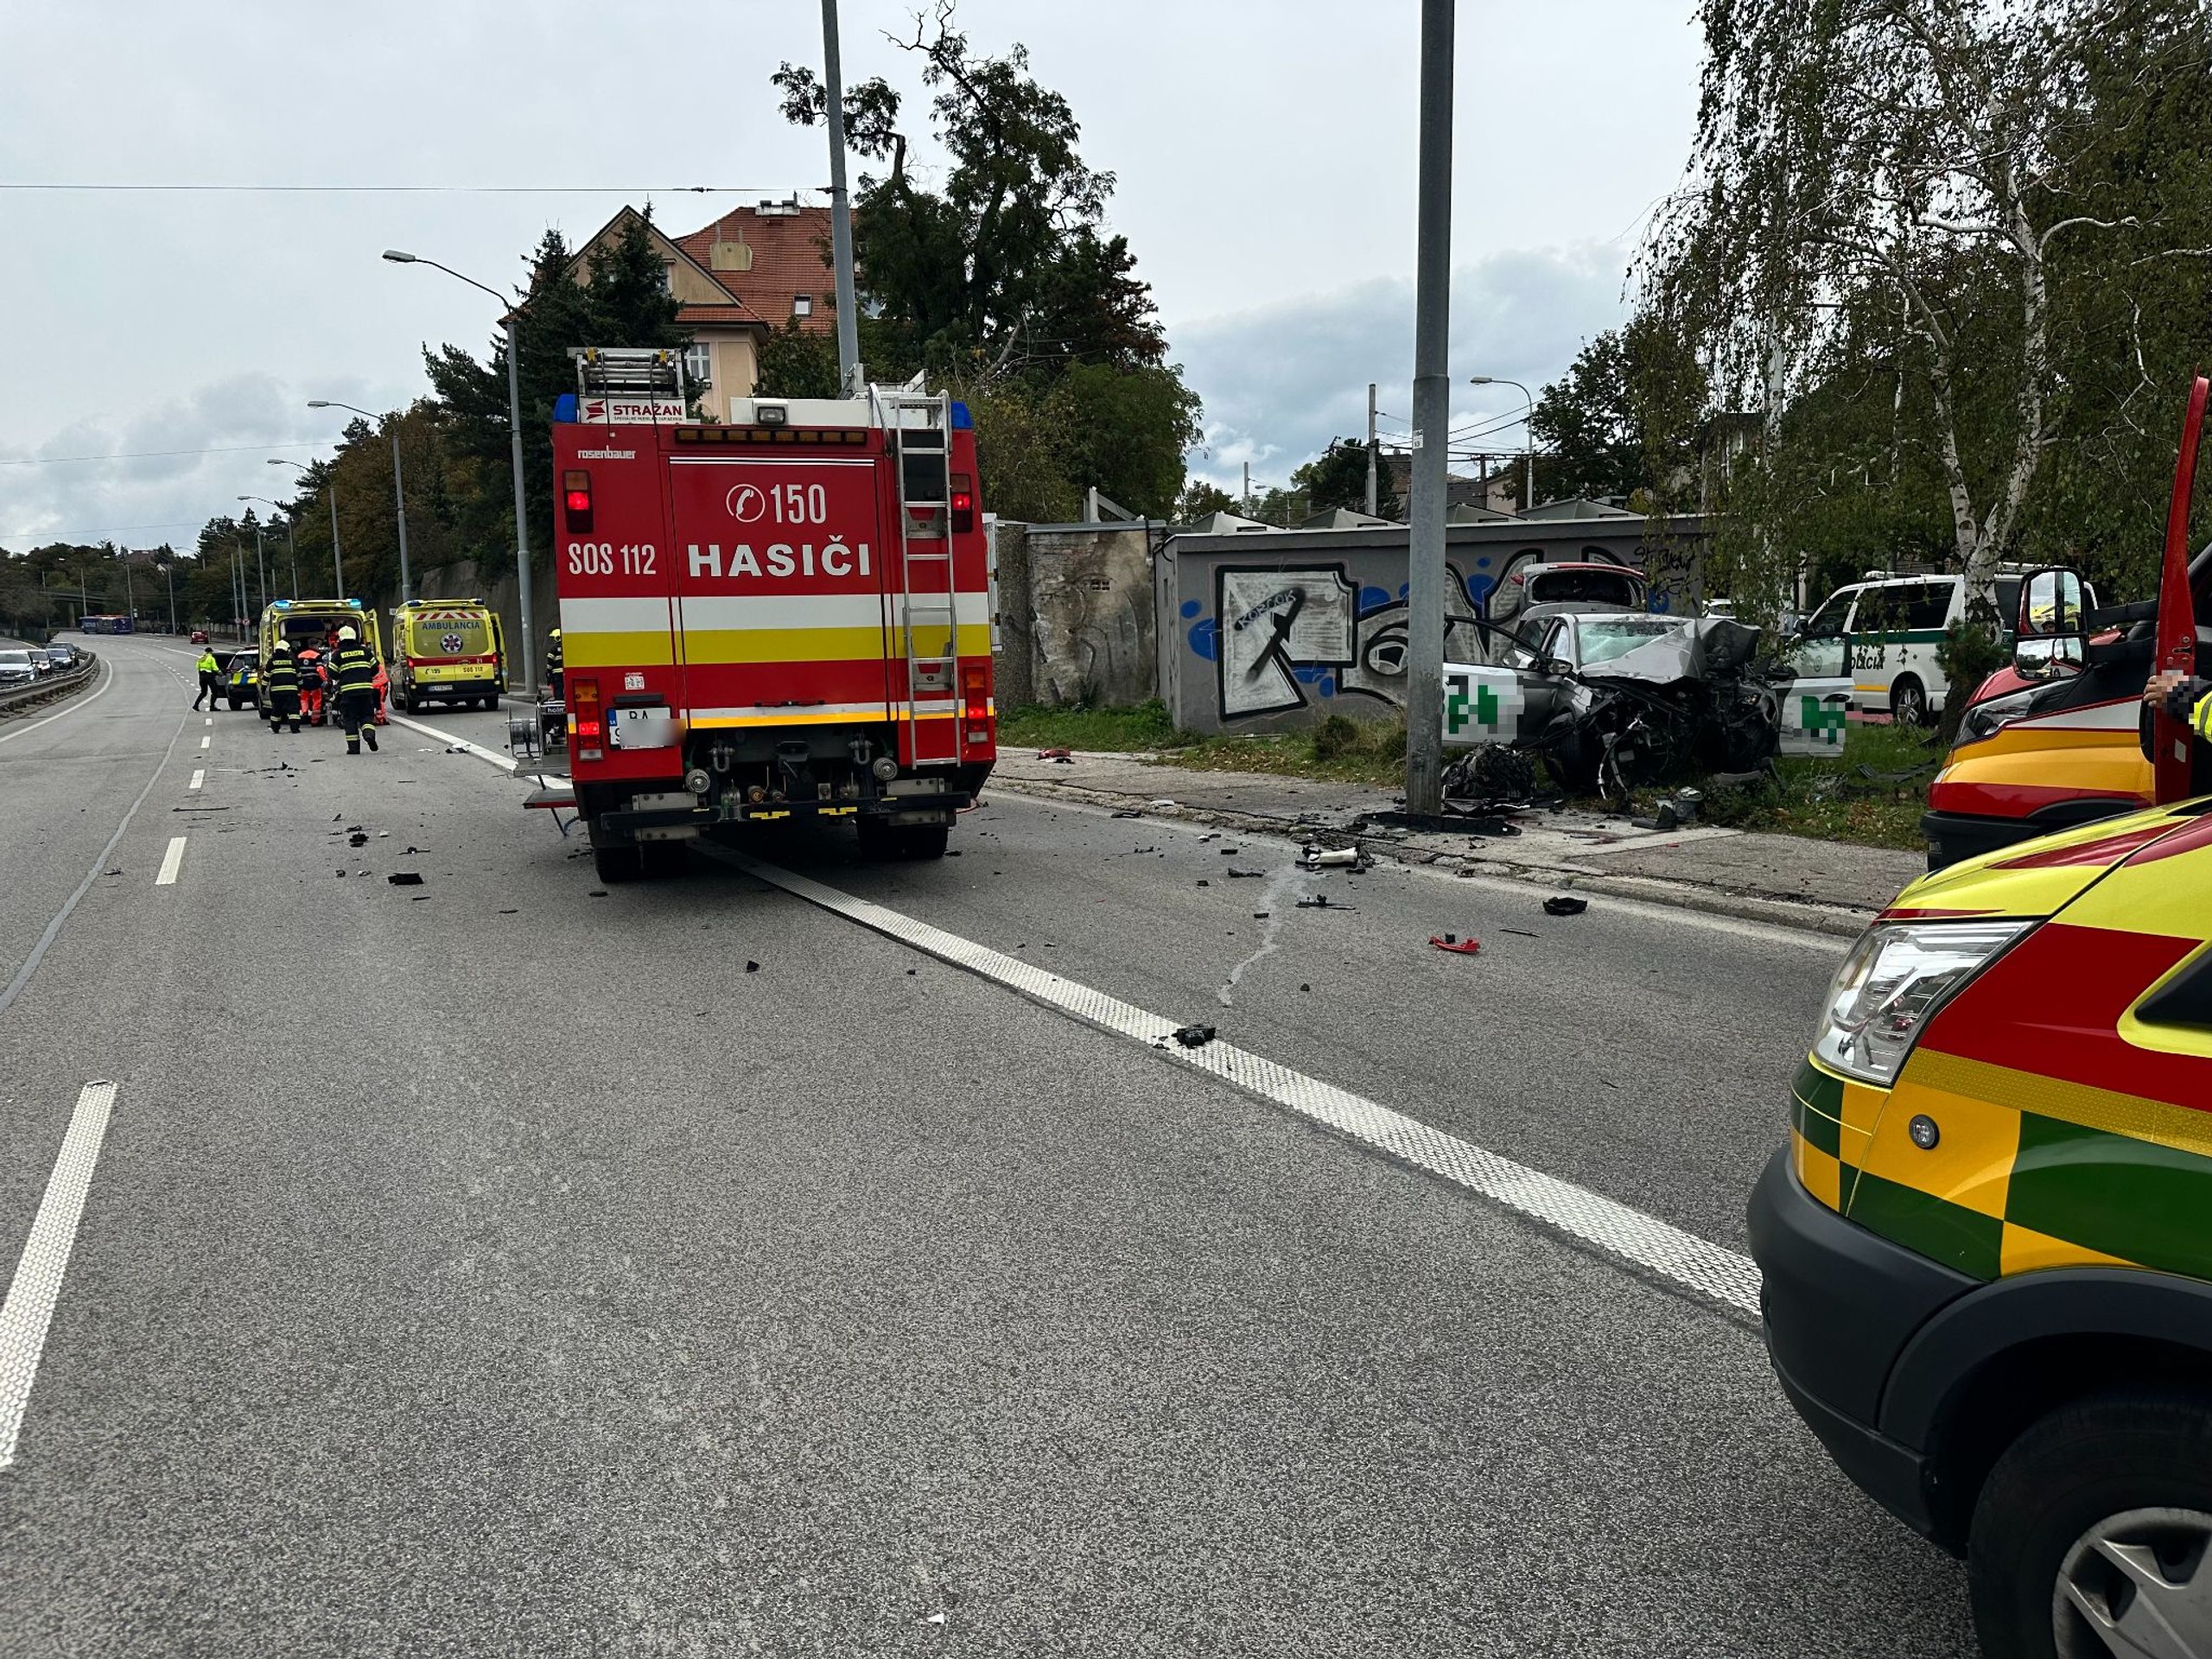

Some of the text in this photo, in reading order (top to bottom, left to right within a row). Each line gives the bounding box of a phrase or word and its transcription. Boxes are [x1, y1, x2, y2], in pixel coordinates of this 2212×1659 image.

[613, 403, 682, 416] STRAŽAN
[577, 445, 636, 460] rosenbauer
[770, 483, 827, 524] 150
[568, 543, 657, 575] SOS 112
[687, 534, 871, 577] HASIČI
[422, 621, 480, 630] AMBULANCIA
